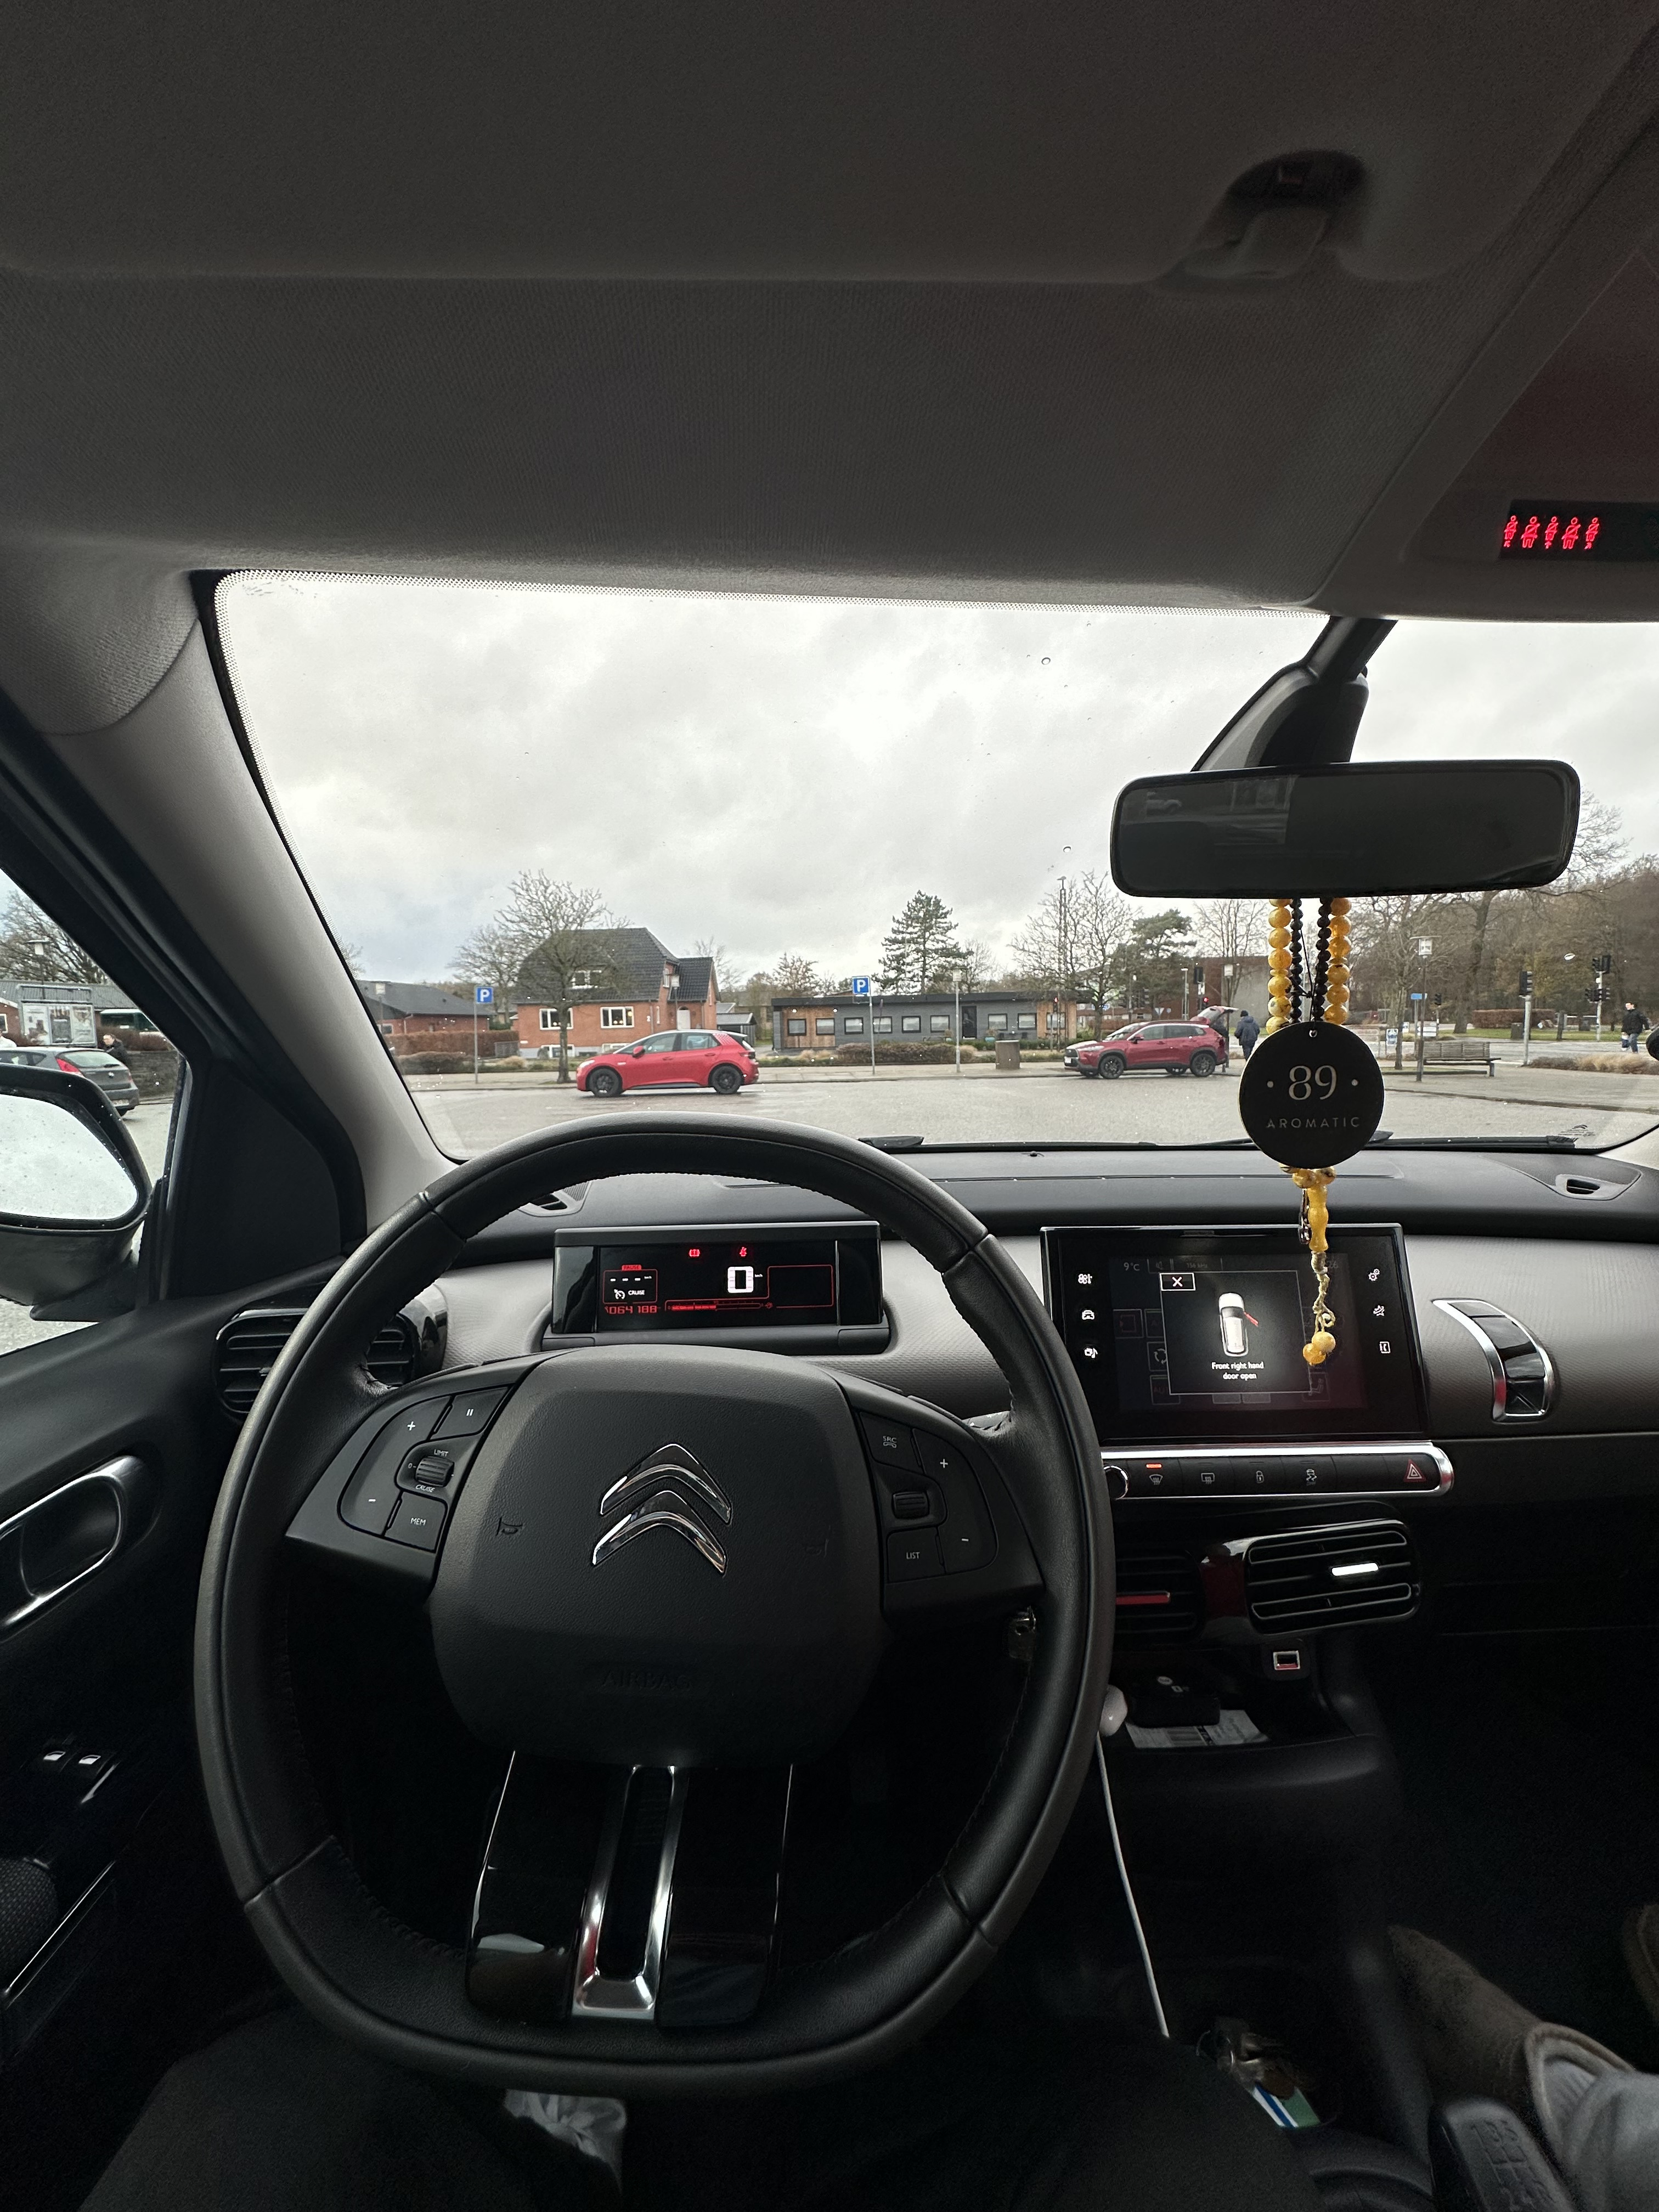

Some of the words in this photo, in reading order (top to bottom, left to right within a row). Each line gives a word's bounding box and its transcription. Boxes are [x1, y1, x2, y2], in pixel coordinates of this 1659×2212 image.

[857, 979, 866, 992] P
[480, 989, 490, 1002] P
[1288, 1064, 1338, 1101] 89
[1266, 1116, 1360, 1128] AROMATIC
[727, 1266, 754, 1293] 0
[1231, 1362, 1247, 1371] right
[1248, 1361, 1264, 1369] hand
[433, 1449, 449, 1457] LIMIT
[415, 1484, 436, 1493] CRUISE
[410, 1517, 427, 1526] MEM
[906, 1551, 921, 1560] LIST
